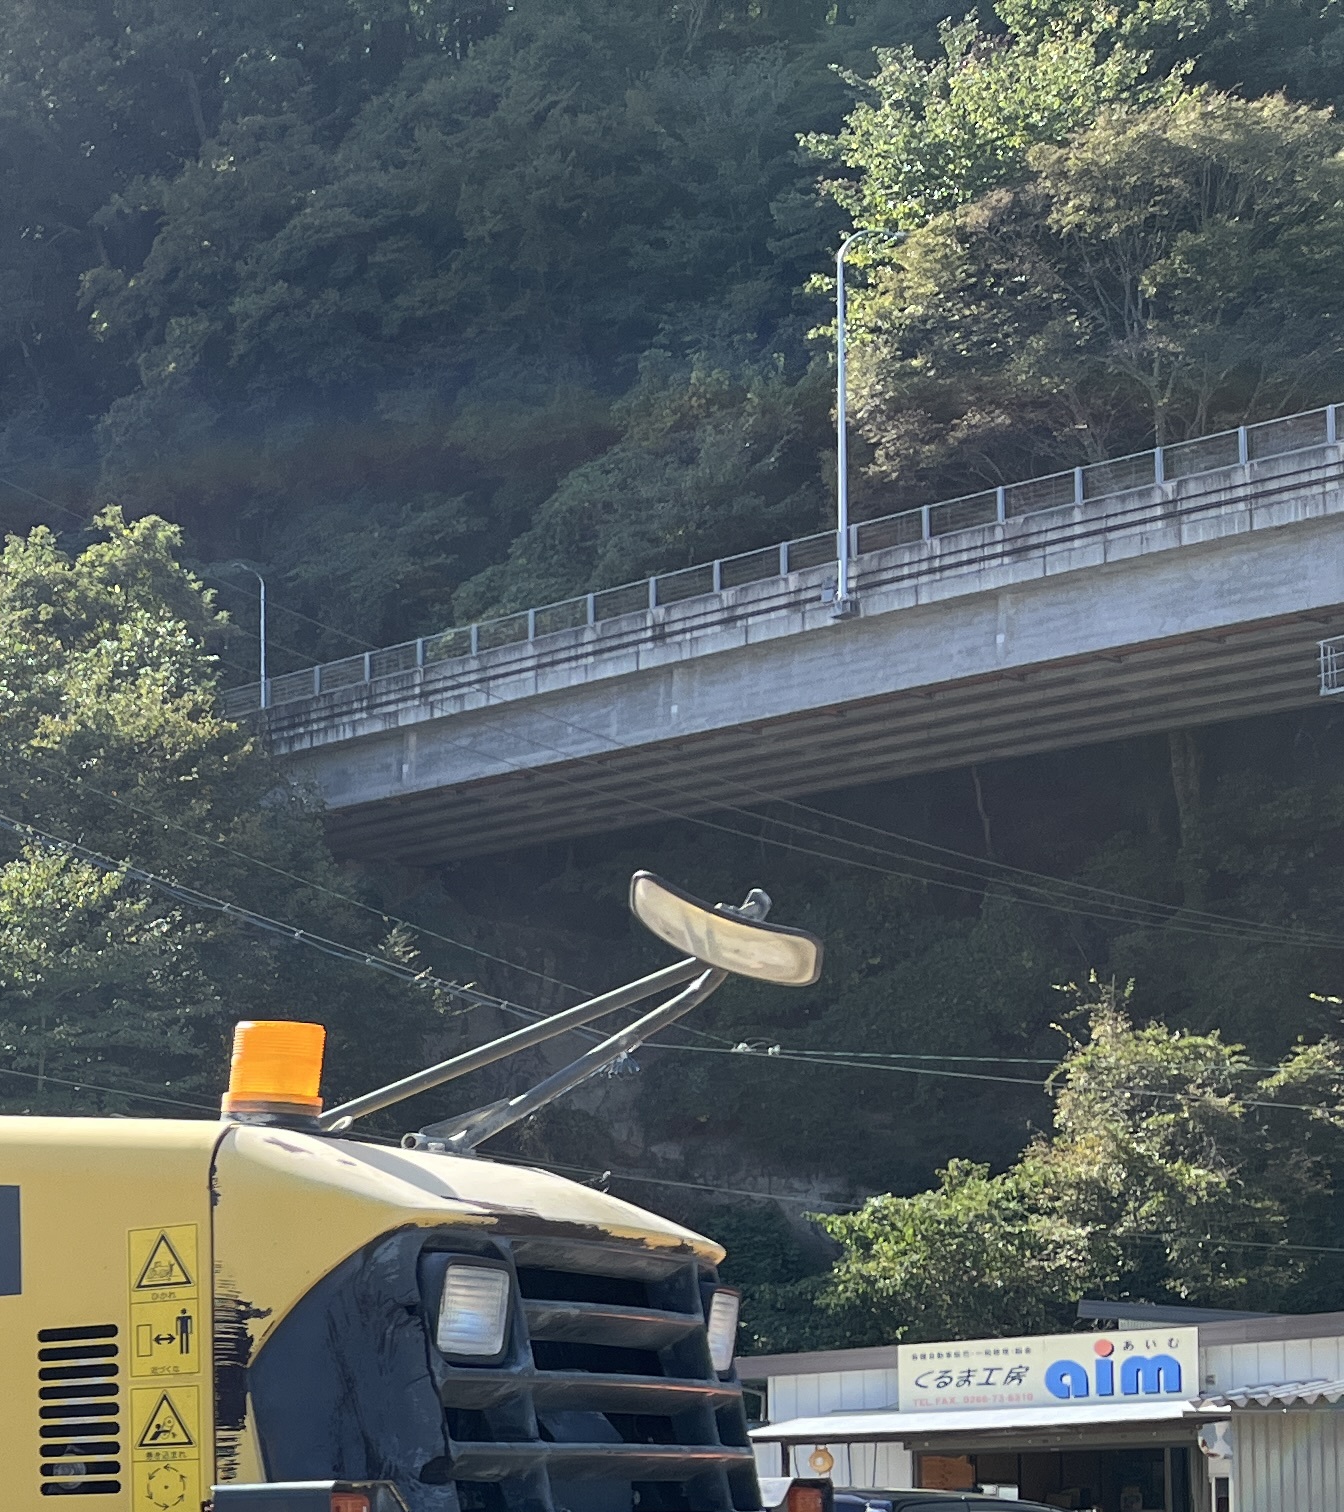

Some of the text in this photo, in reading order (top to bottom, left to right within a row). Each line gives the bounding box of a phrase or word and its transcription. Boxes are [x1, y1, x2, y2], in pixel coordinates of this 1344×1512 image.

[914, 1364, 1030, 1389] くるま工房
[1045, 1338, 1182, 1400] aim
